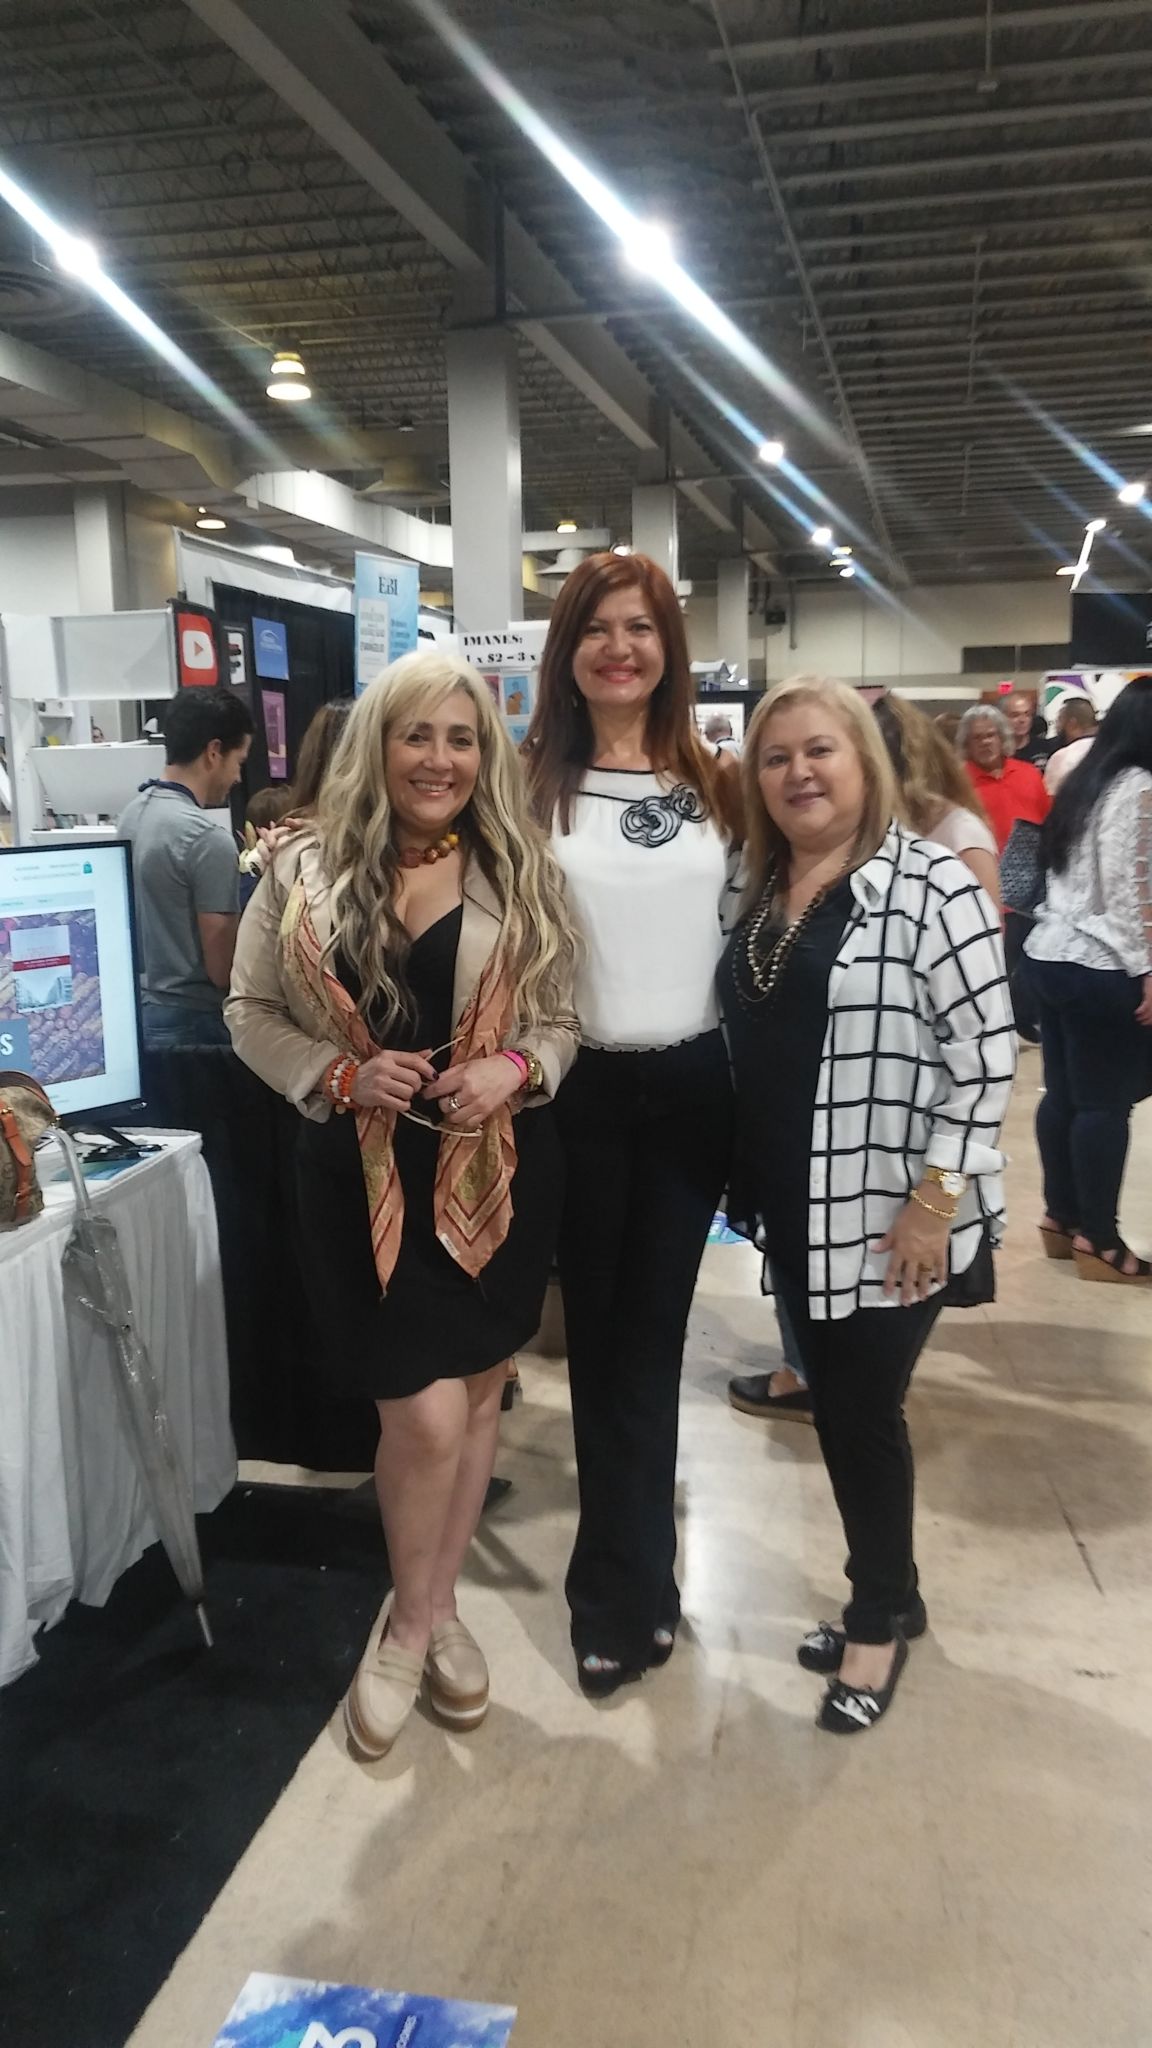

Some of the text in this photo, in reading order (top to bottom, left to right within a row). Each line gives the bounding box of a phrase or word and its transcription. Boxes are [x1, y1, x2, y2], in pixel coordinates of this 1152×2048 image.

[378, 576, 398, 596] EBI
[464, 634, 523, 646] IMANES:
[518, 652, 525, 661] 3
